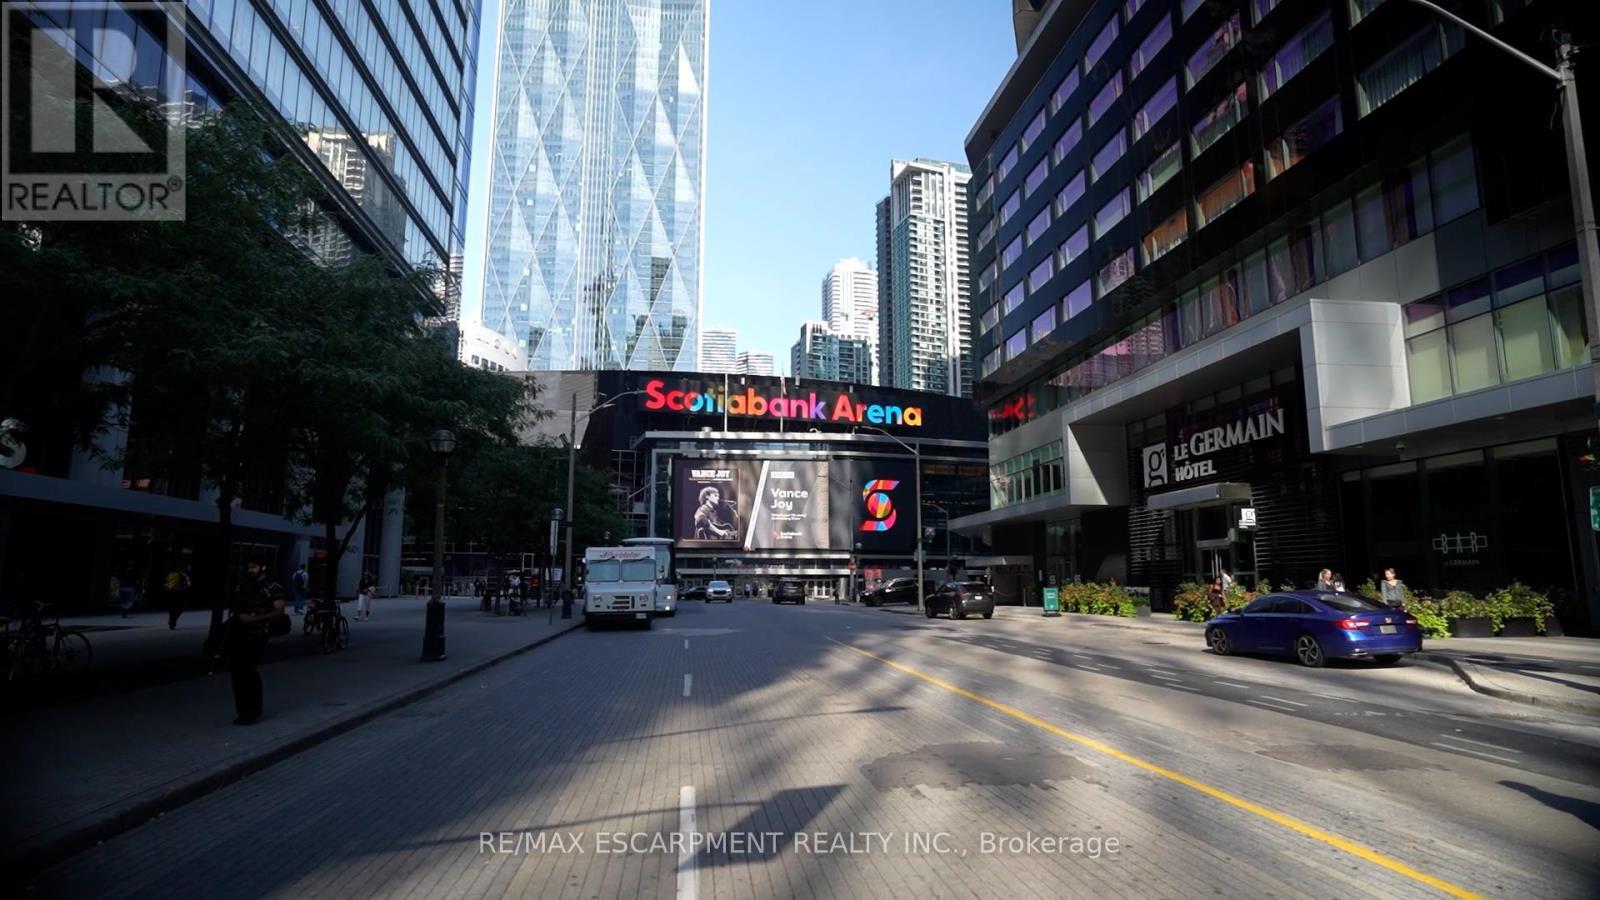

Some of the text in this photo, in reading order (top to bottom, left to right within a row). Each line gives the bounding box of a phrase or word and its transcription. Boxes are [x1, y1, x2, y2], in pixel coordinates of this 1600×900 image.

[645, 379, 922, 426] Scotiabank Arena
[1173, 408, 1285, 461] LE GERMAIN
[691, 469, 731, 478] VANCE JOY
[1175, 459, 1217, 482] HÔTEL
[771, 488, 808, 498] Vance
[771, 500, 793, 511] Joy
